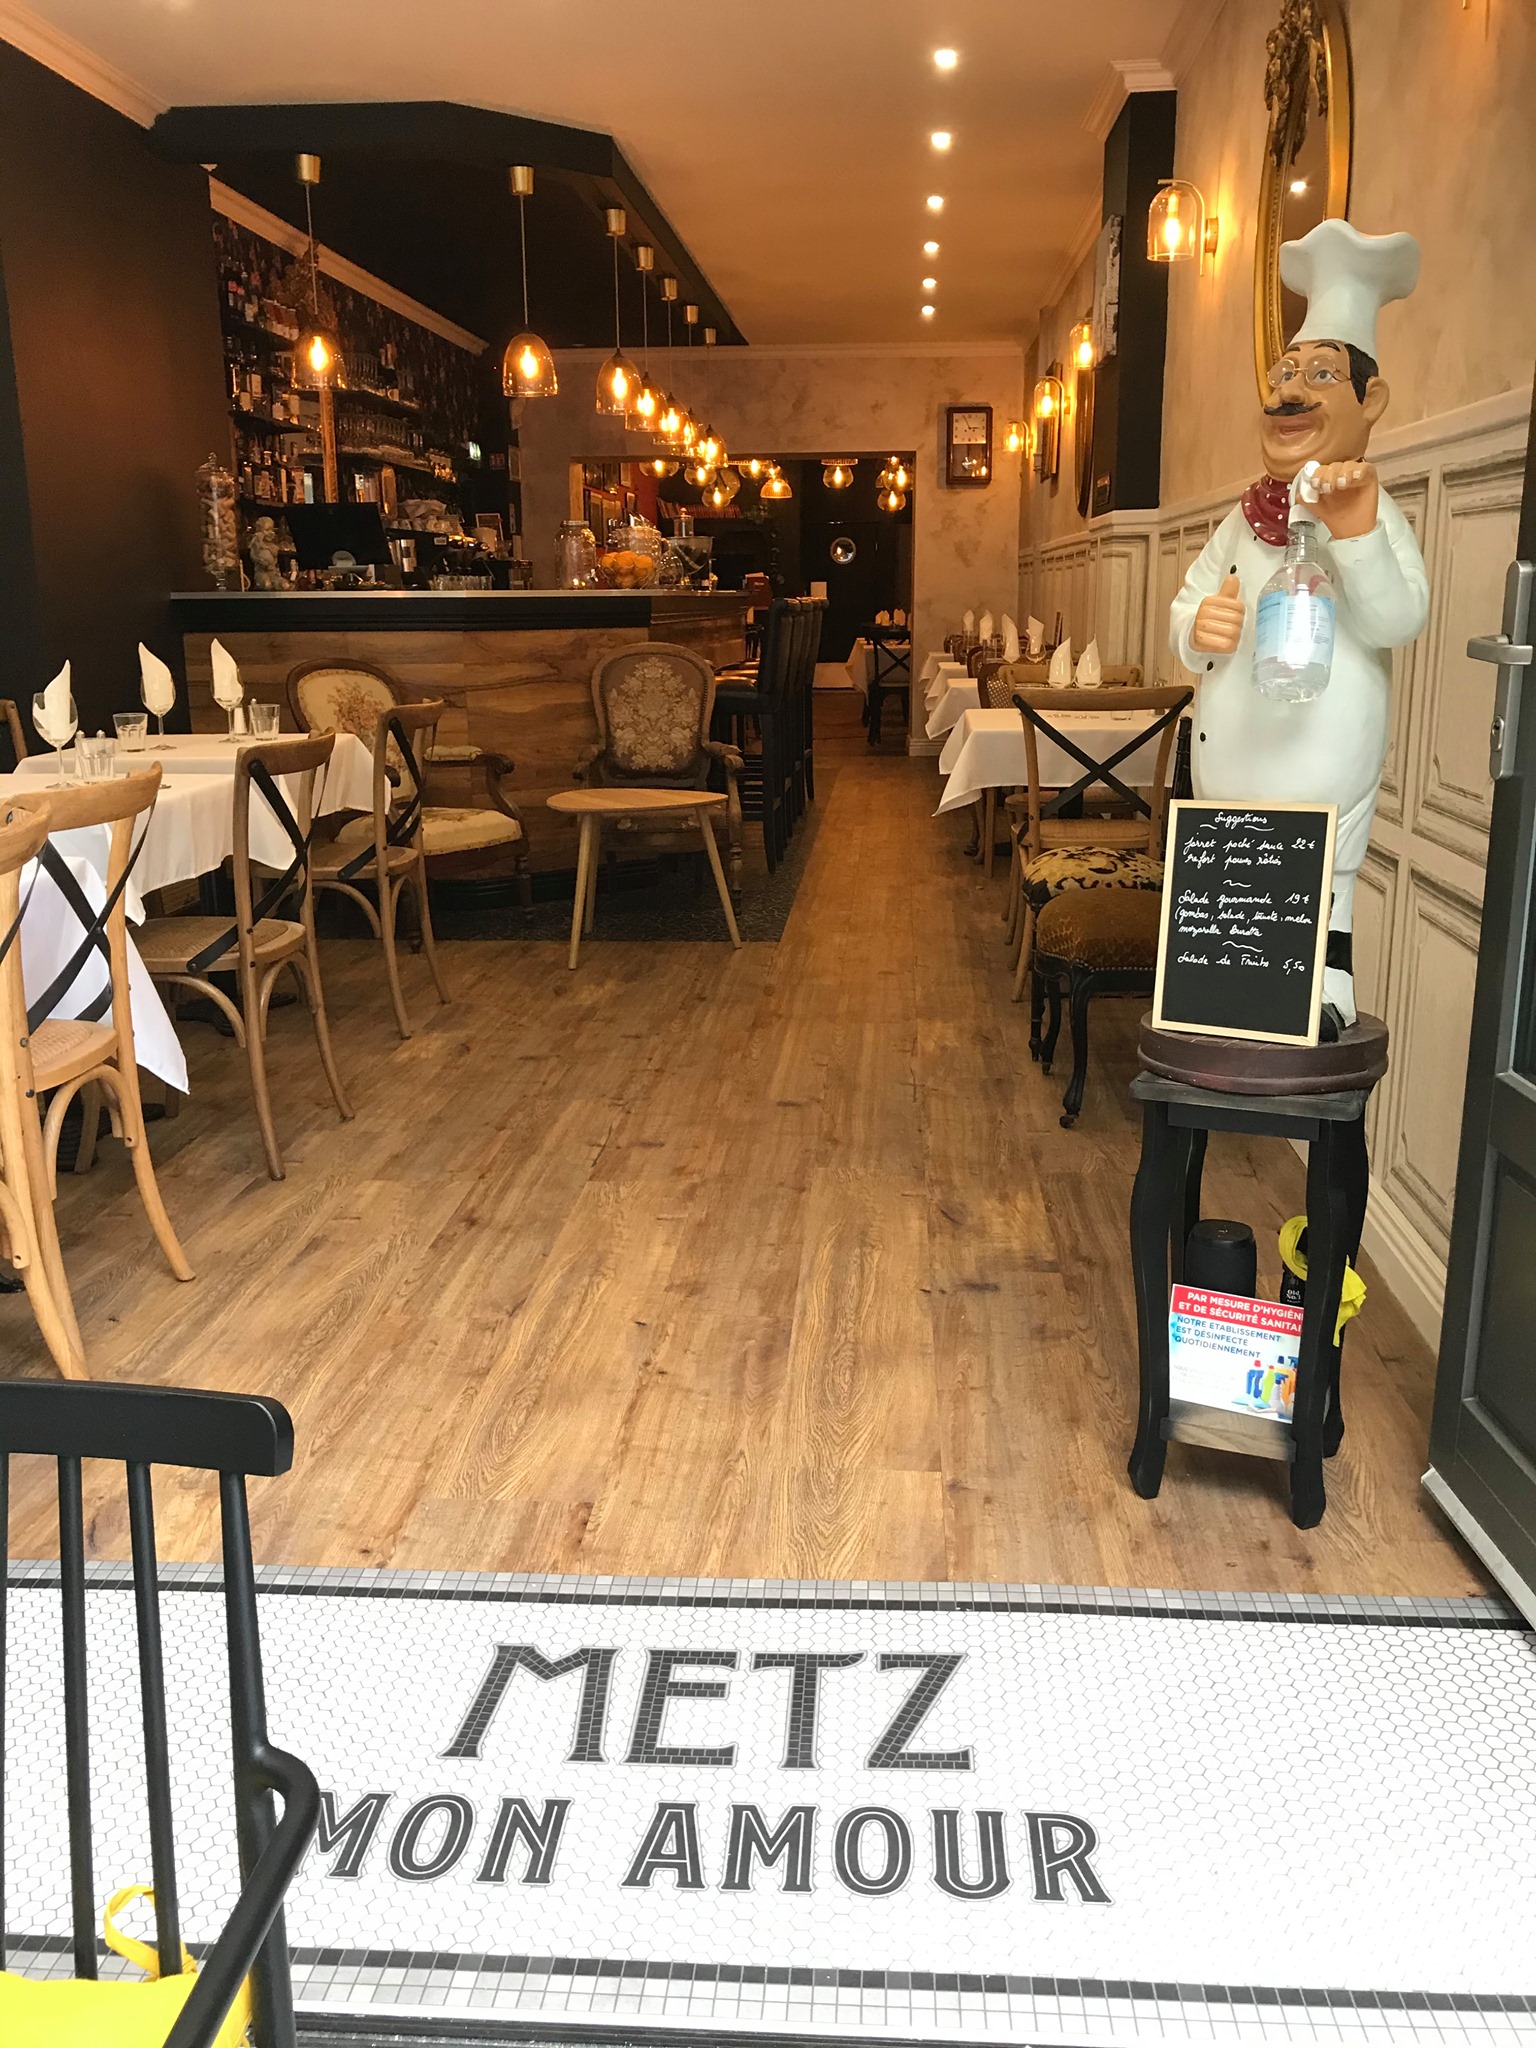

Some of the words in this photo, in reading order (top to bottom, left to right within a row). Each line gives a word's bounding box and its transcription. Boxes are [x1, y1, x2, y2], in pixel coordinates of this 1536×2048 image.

[1214, 811, 1268, 829] Suggestions
[1178, 889, 1210, 904] Salade
[1177, 951, 1209, 965] Salade
[1215, 953, 1231, 966] de
[1187, 1291, 1208, 1303] PAR
[1209, 1296, 1250, 1311] MESURE
[1178, 1301, 1192, 1311] ET
[1193, 1303, 1208, 1314] DE
[1209, 1306, 1259, 1324] SÉCURITÉ
[1176, 1325, 1192, 1335] EST
[1194, 1328, 1249, 1347] DÉSINFECTÉ
[1177, 1316, 1207, 1328] NOTRE
[1209, 1319, 1282, 1343] ETABLISSEMENT
[1175, 1335, 1261, 1359] QUOTIDIENNEMENT
[437, 1643, 976, 1773] METZ
[296, 1790, 572, 1885] MON
[619, 1800, 1115, 1905] AMOUR
